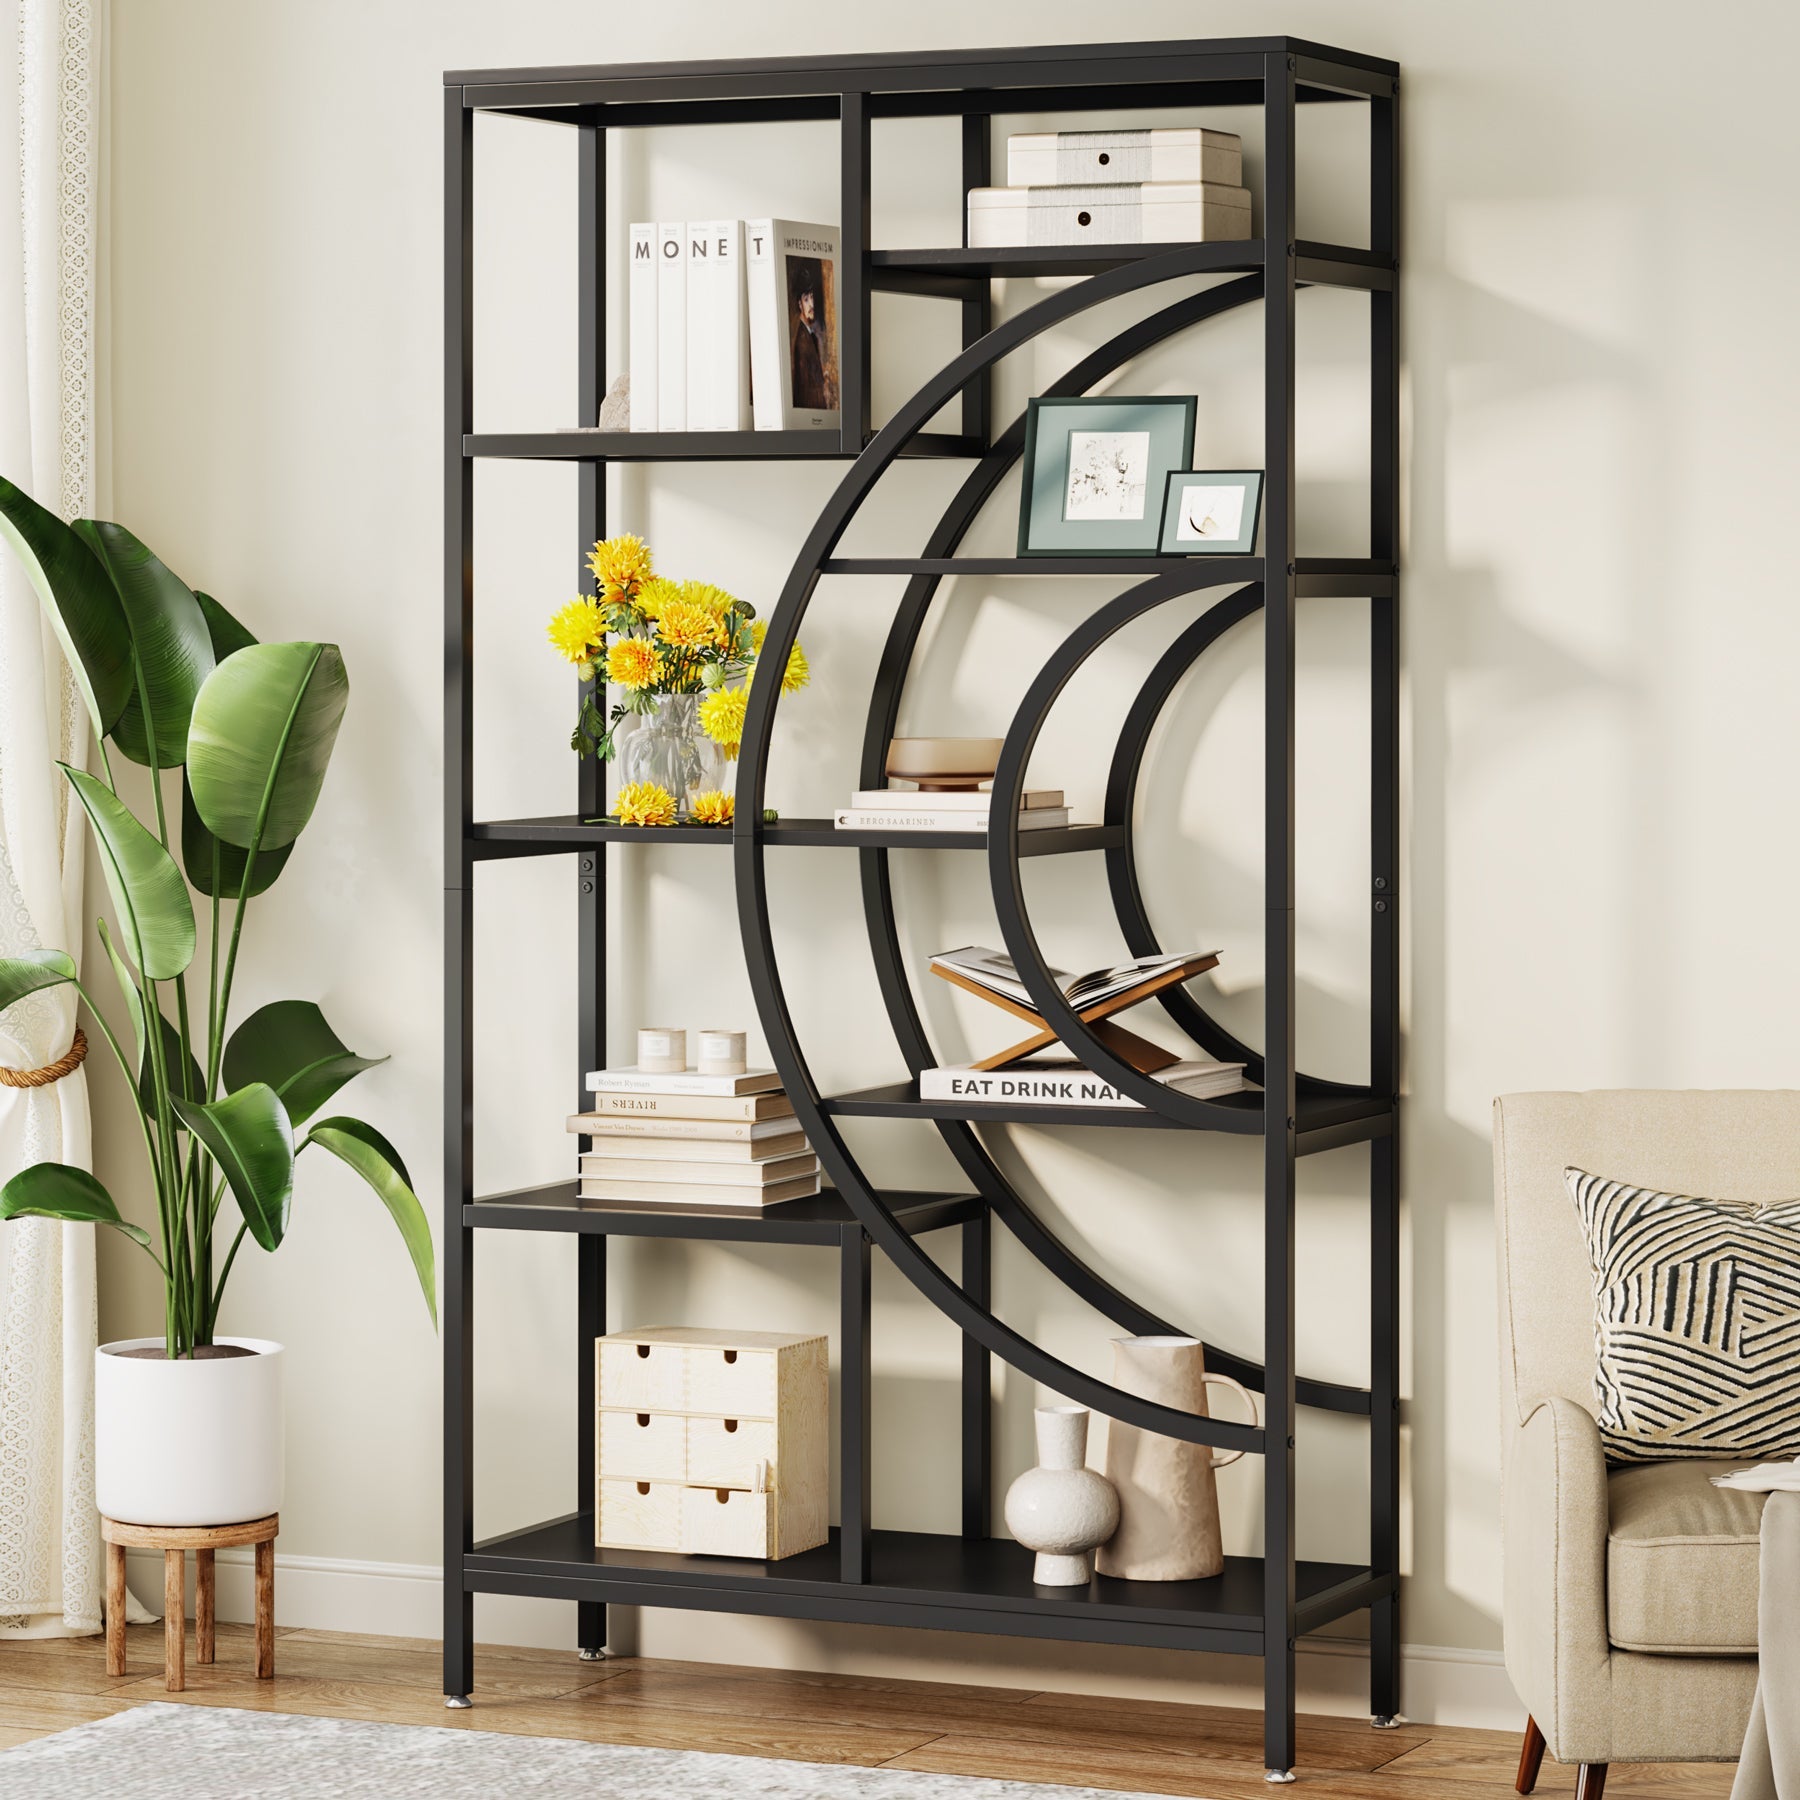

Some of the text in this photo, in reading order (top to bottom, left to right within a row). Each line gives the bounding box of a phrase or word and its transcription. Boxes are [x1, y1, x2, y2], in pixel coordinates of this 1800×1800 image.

[784, 238, 833, 253] IMPRESSIONISM
[859, 817, 935, 826] EERO SAARINEN
[598, 1078, 650, 1089] Robert Ryman
[951, 1079, 993, 1096] EAT
[1001, 1081, 1073, 1099] DRINK
[612, 1099, 657, 1110] RIVERS
